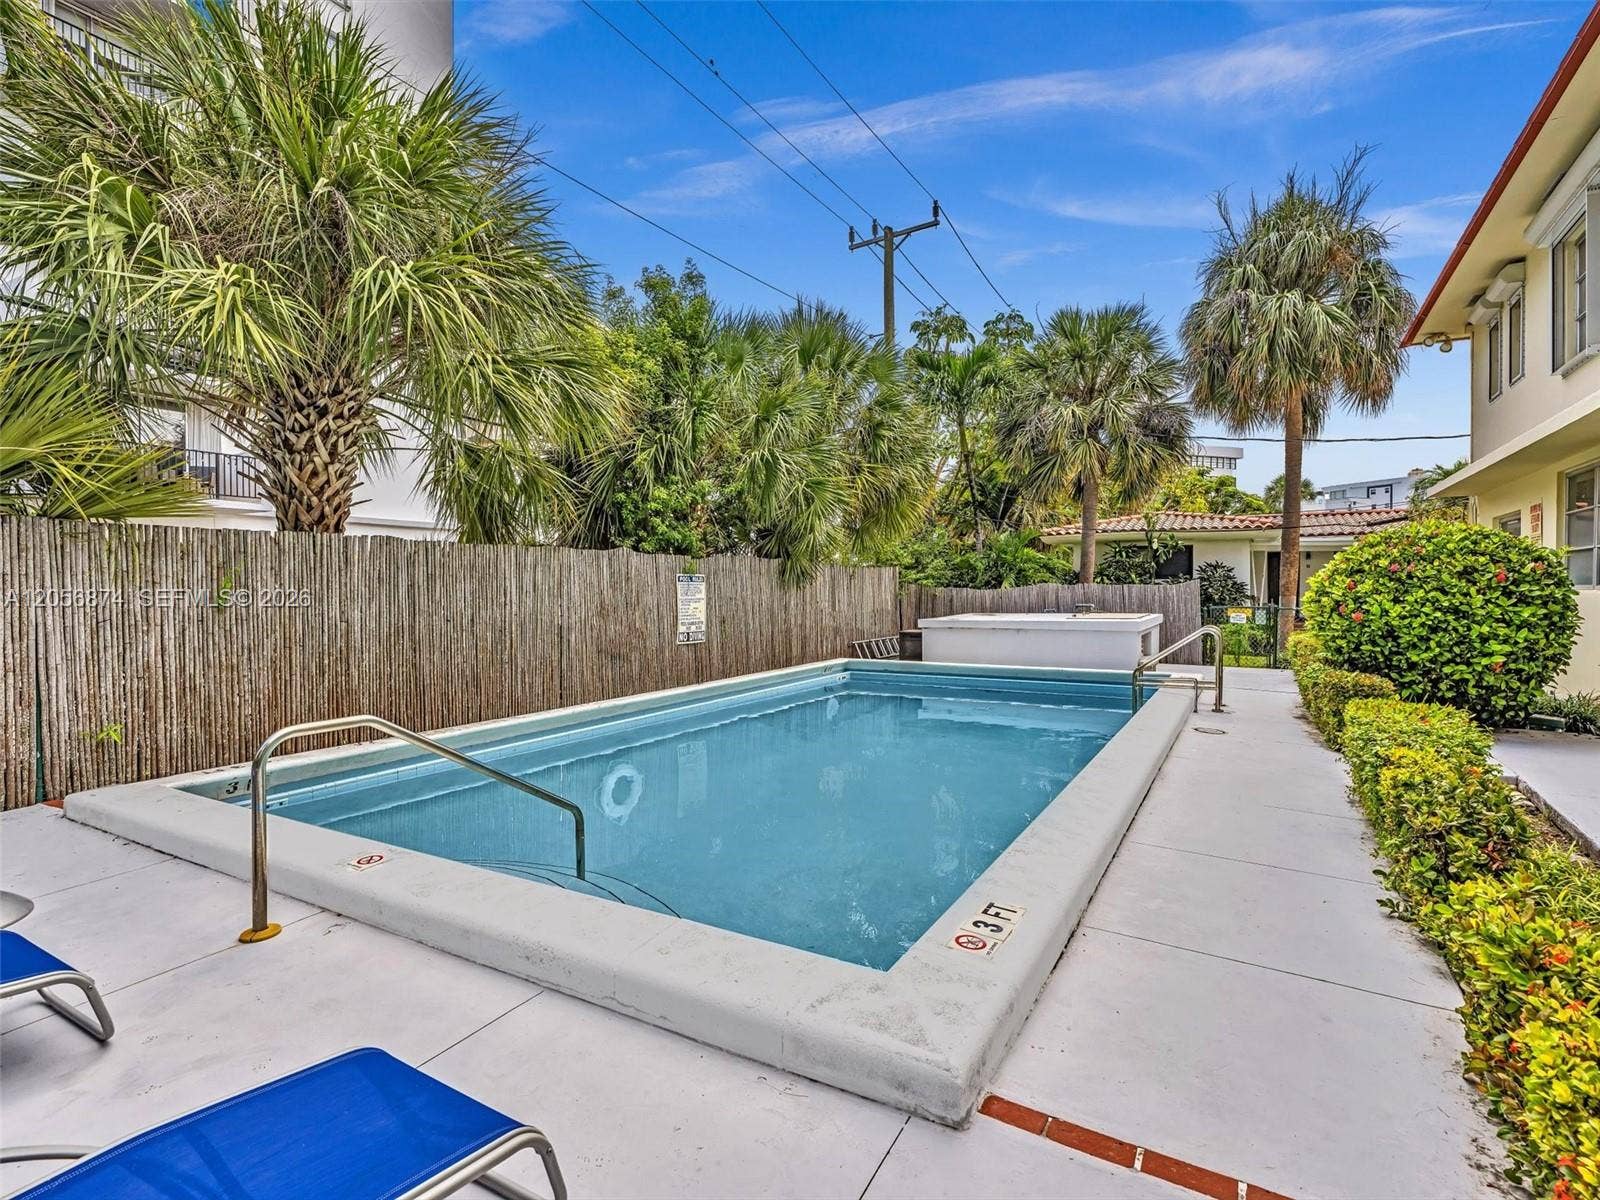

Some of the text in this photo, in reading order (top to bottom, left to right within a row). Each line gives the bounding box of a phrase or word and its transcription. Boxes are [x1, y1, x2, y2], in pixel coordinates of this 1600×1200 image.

[679, 632, 688, 642] NO
[225, 781, 239, 794] 3
[972, 902, 1017, 933] 3 FT
